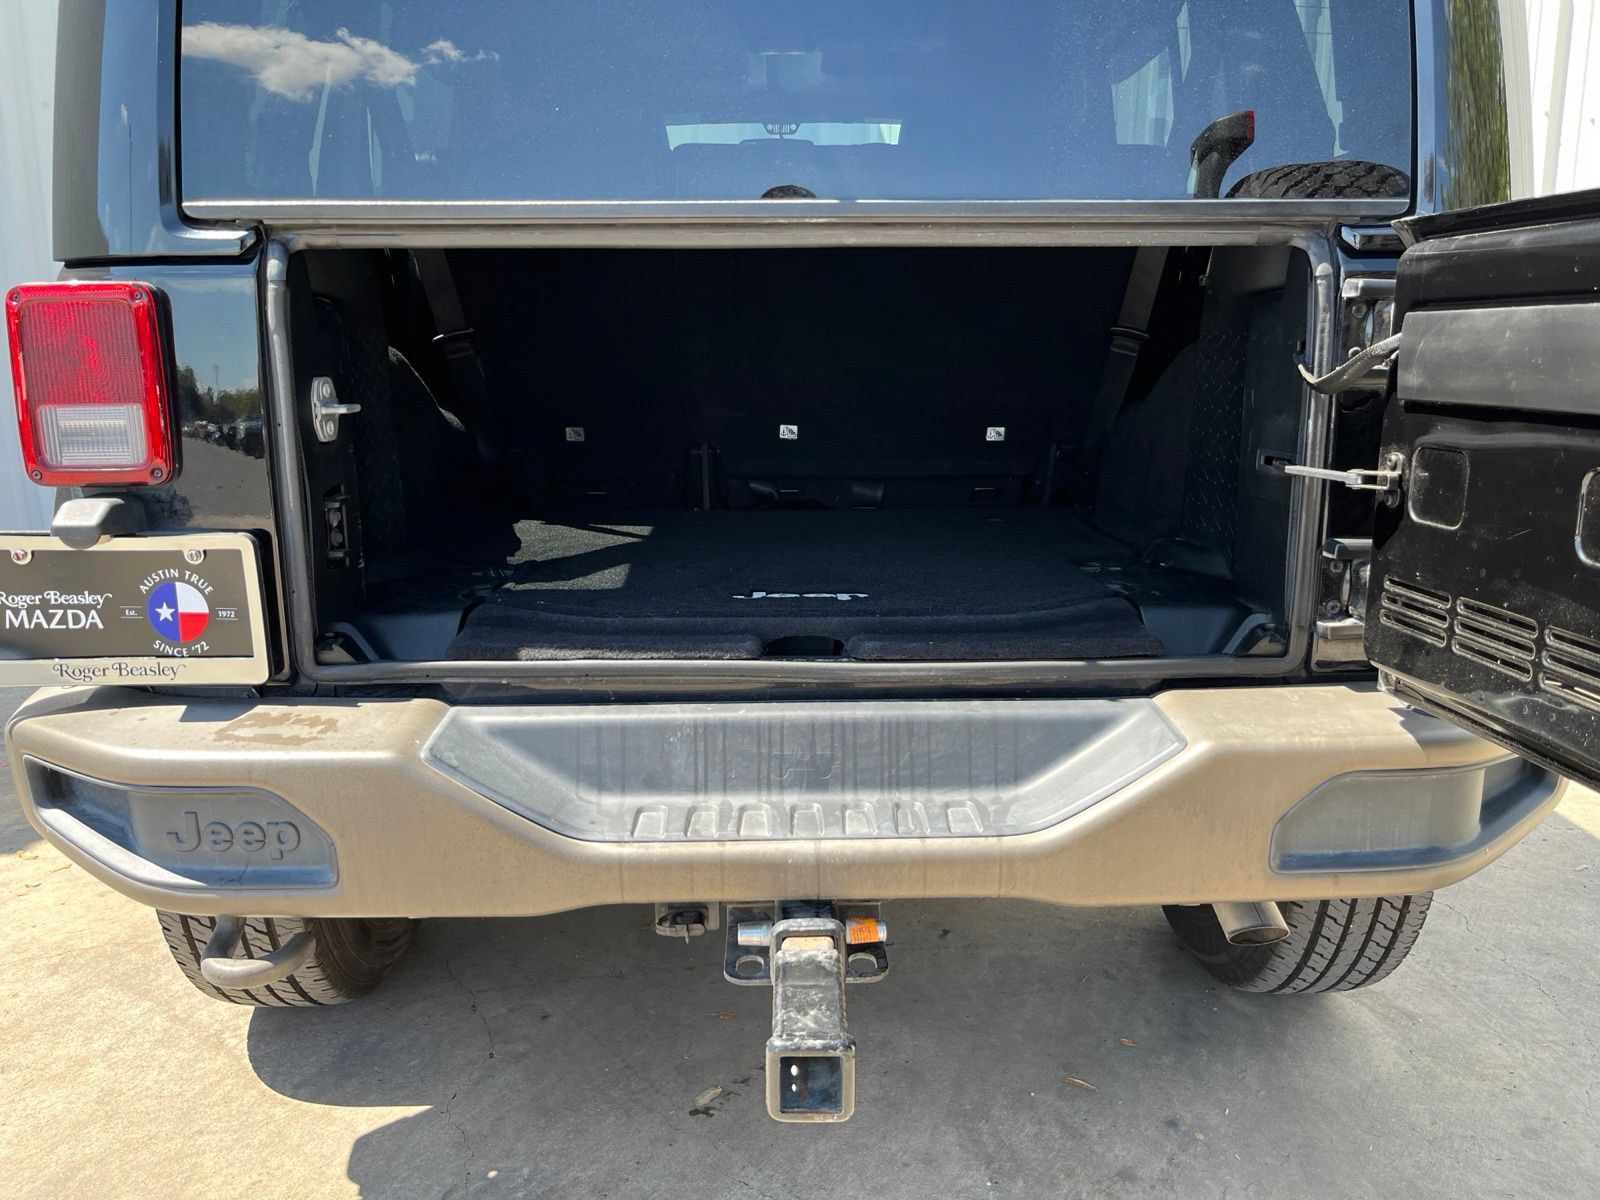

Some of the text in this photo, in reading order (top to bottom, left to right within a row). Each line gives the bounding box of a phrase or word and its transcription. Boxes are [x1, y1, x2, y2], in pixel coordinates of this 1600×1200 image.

[139, 568, 214, 595] AUSTIN TRUE
[44, 590, 113, 608] Beasley
[5, 609, 104, 629] MAZDA
[125, 608, 138, 616] Est.
[218, 610, 236, 618] 1972
[153, 640, 210, 657] SINCE '72
[53, 662, 186, 682] Roger Beasley
[166, 811, 300, 860] Jeep
